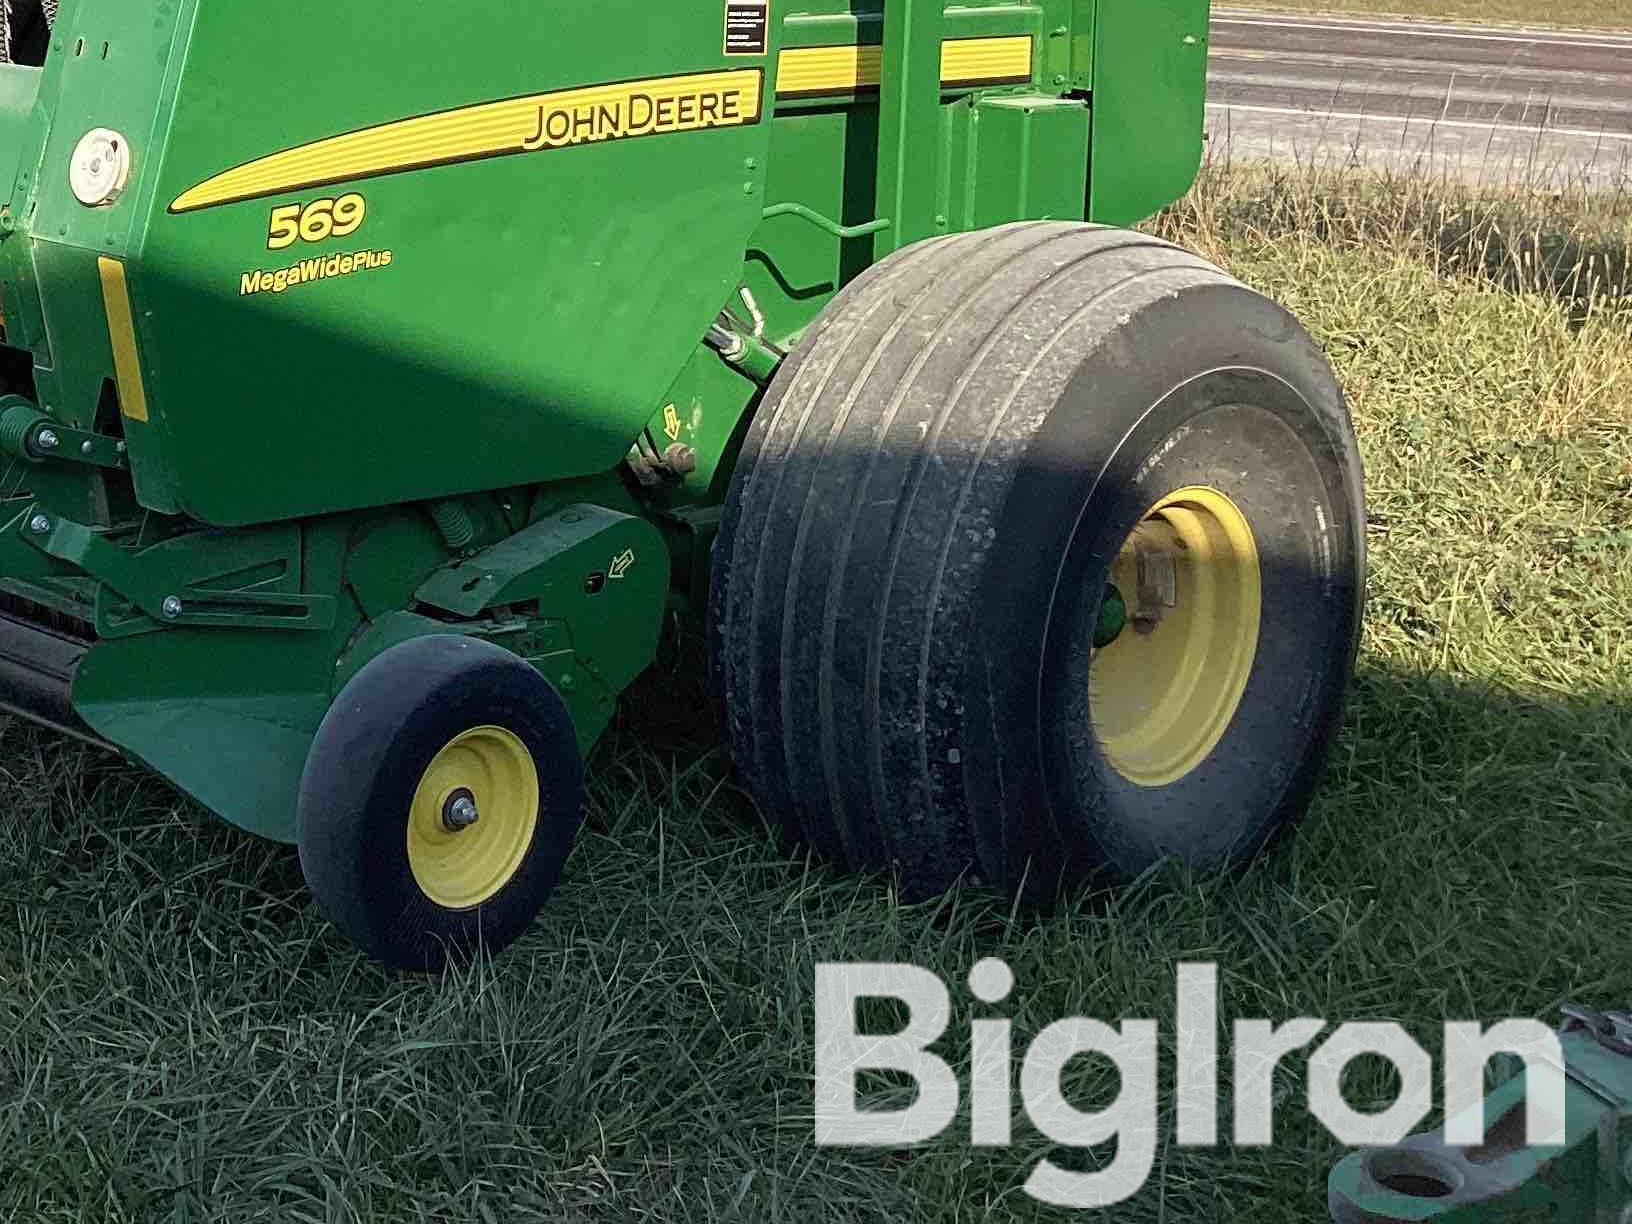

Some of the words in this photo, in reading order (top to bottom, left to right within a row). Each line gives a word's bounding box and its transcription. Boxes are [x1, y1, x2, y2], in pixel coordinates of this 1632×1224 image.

[524, 102, 621, 145] JOHN
[628, 89, 741, 130] DEERE
[267, 192, 367, 250] 569
[239, 249, 393, 296] MegaWidePlus
